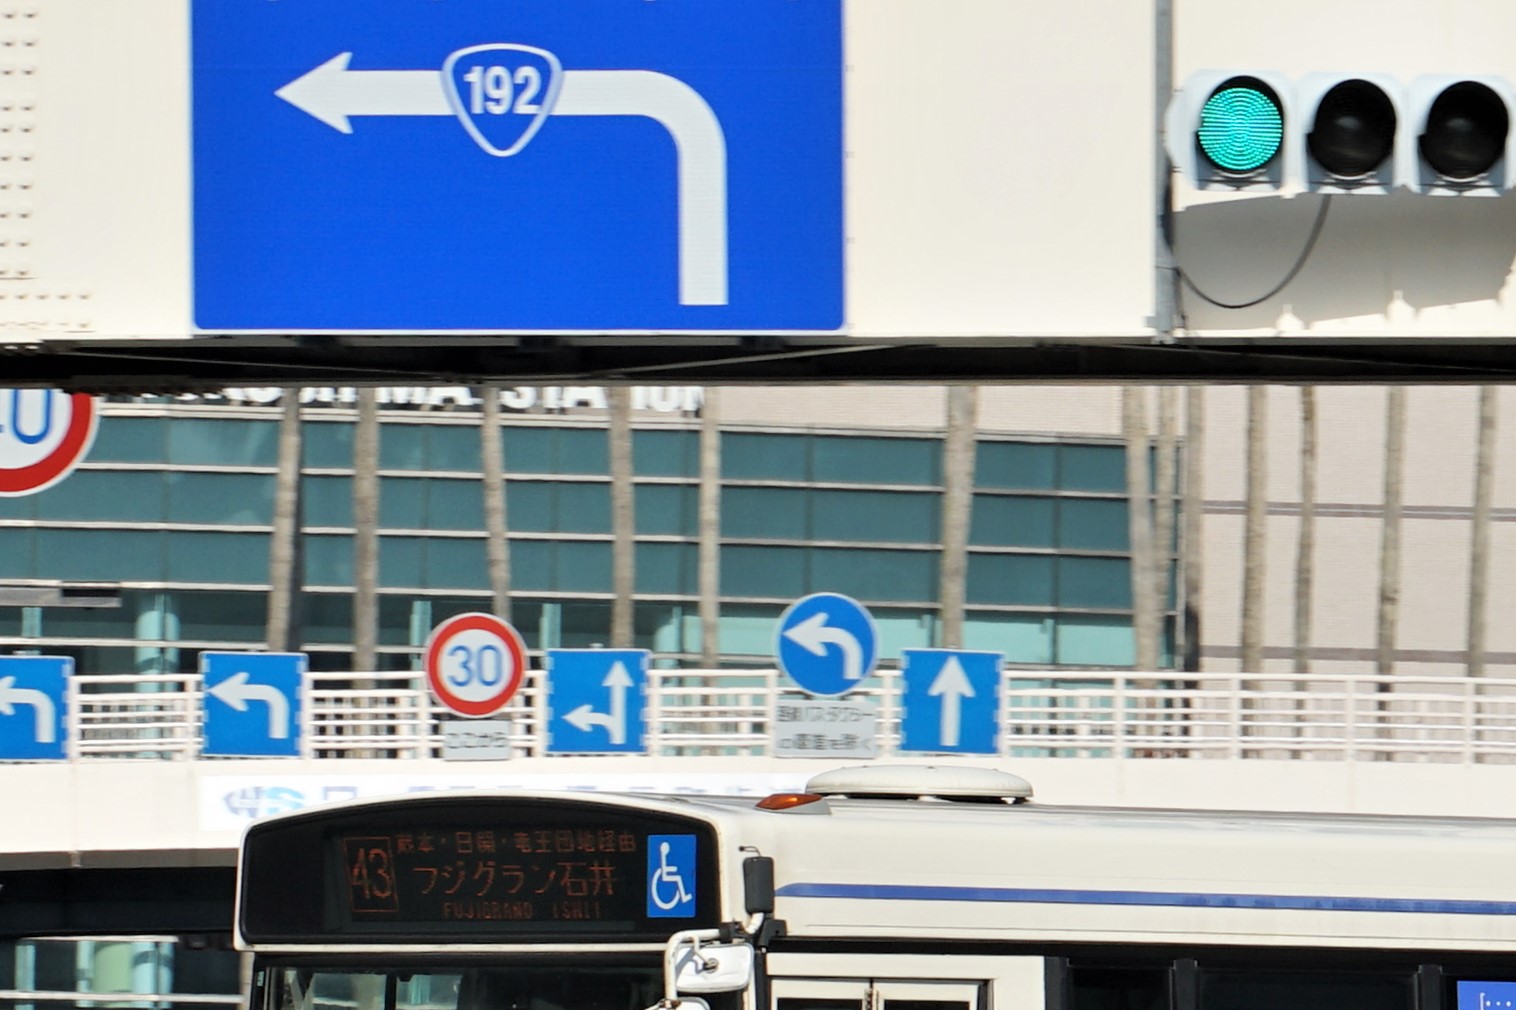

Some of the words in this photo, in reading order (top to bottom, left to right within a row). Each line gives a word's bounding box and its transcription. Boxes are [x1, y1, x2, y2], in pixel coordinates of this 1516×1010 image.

[463, 66, 541, 116] 192
[447, 644, 502, 687] 30
[351, 848, 393, 898] 43
[412, 860, 616, 897] フジグラン石井
